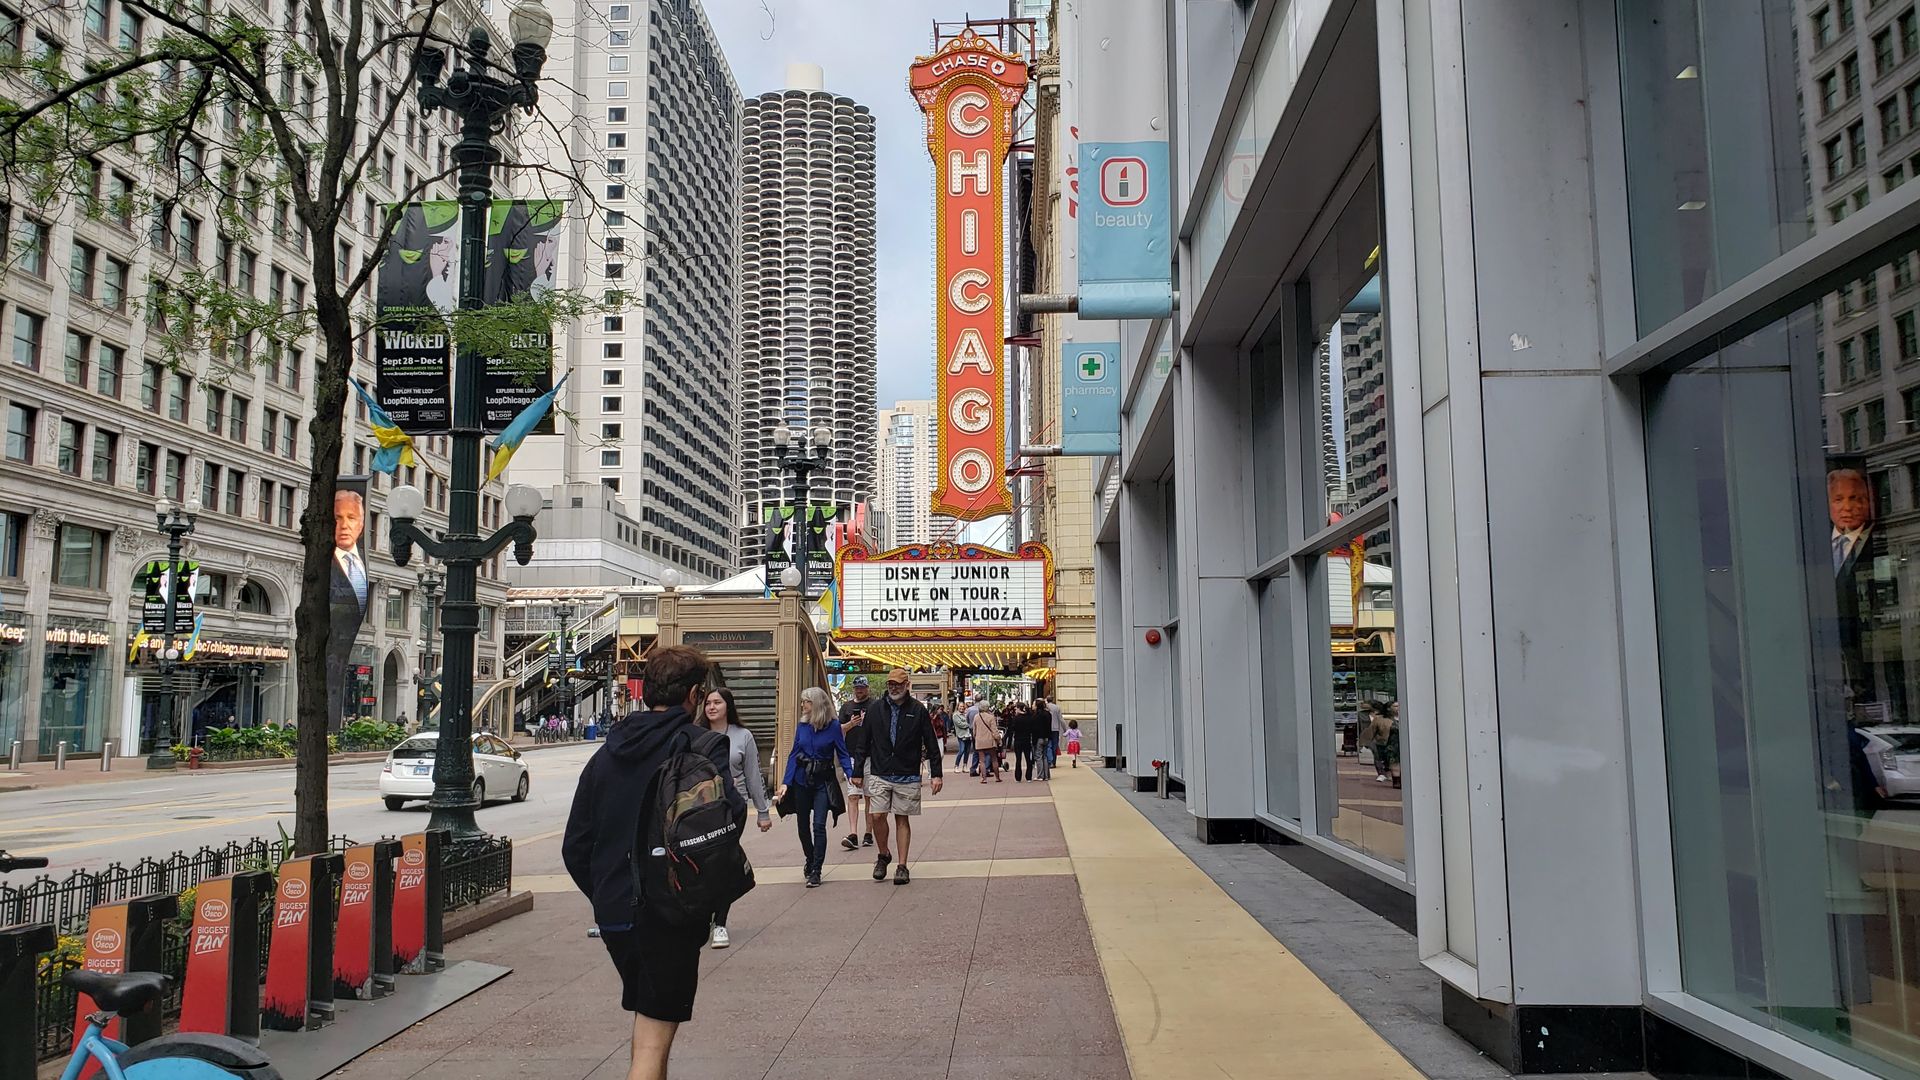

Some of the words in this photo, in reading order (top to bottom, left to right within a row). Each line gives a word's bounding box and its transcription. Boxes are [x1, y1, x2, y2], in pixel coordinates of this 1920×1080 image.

[931, 54, 989, 76] CHASE
[1095, 212, 1153, 229] beauty
[947, 91, 995, 494] CHICAGO
[382, 357, 401, 367] Sept
[402, 357, 414, 365] 28
[420, 357, 437, 365] Dec
[1065, 386, 1118, 397] pharmacy
[383, 397, 445, 405] LoopChicago.com
[885, 566, 940, 580] DISNEY
[951, 566, 1010, 580] JUNIOR
[886, 588, 920, 601] LIVE
[930, 587, 949, 601] ON
[960, 587, 1008, 600] TOUR:
[871, 608, 940, 622] COSTUME
[950, 607, 1022, 621] PALOOZA
[46, 628, 67, 642] with
[70, 629, 86, 643] the
[710, 633, 747, 641] SUBWAY
[255, 647, 263, 656] or
[680, 835, 707, 848] HERSCHEL
[707, 827, 728, 840] SUPPLY
[400, 875, 424, 888] FAN
[344, 890, 370, 904] FAN
[205, 903, 224, 911] Jewel
[280, 902, 308, 910] BIGGEST
[278, 910, 306, 926] FAN
[198, 926, 229, 934] BIGGEST
[96, 932, 116, 943] Jewel
[195, 934, 229, 953] FAN
[95, 941, 114, 949] Osco
[87, 959, 123, 968] BIGGEST
